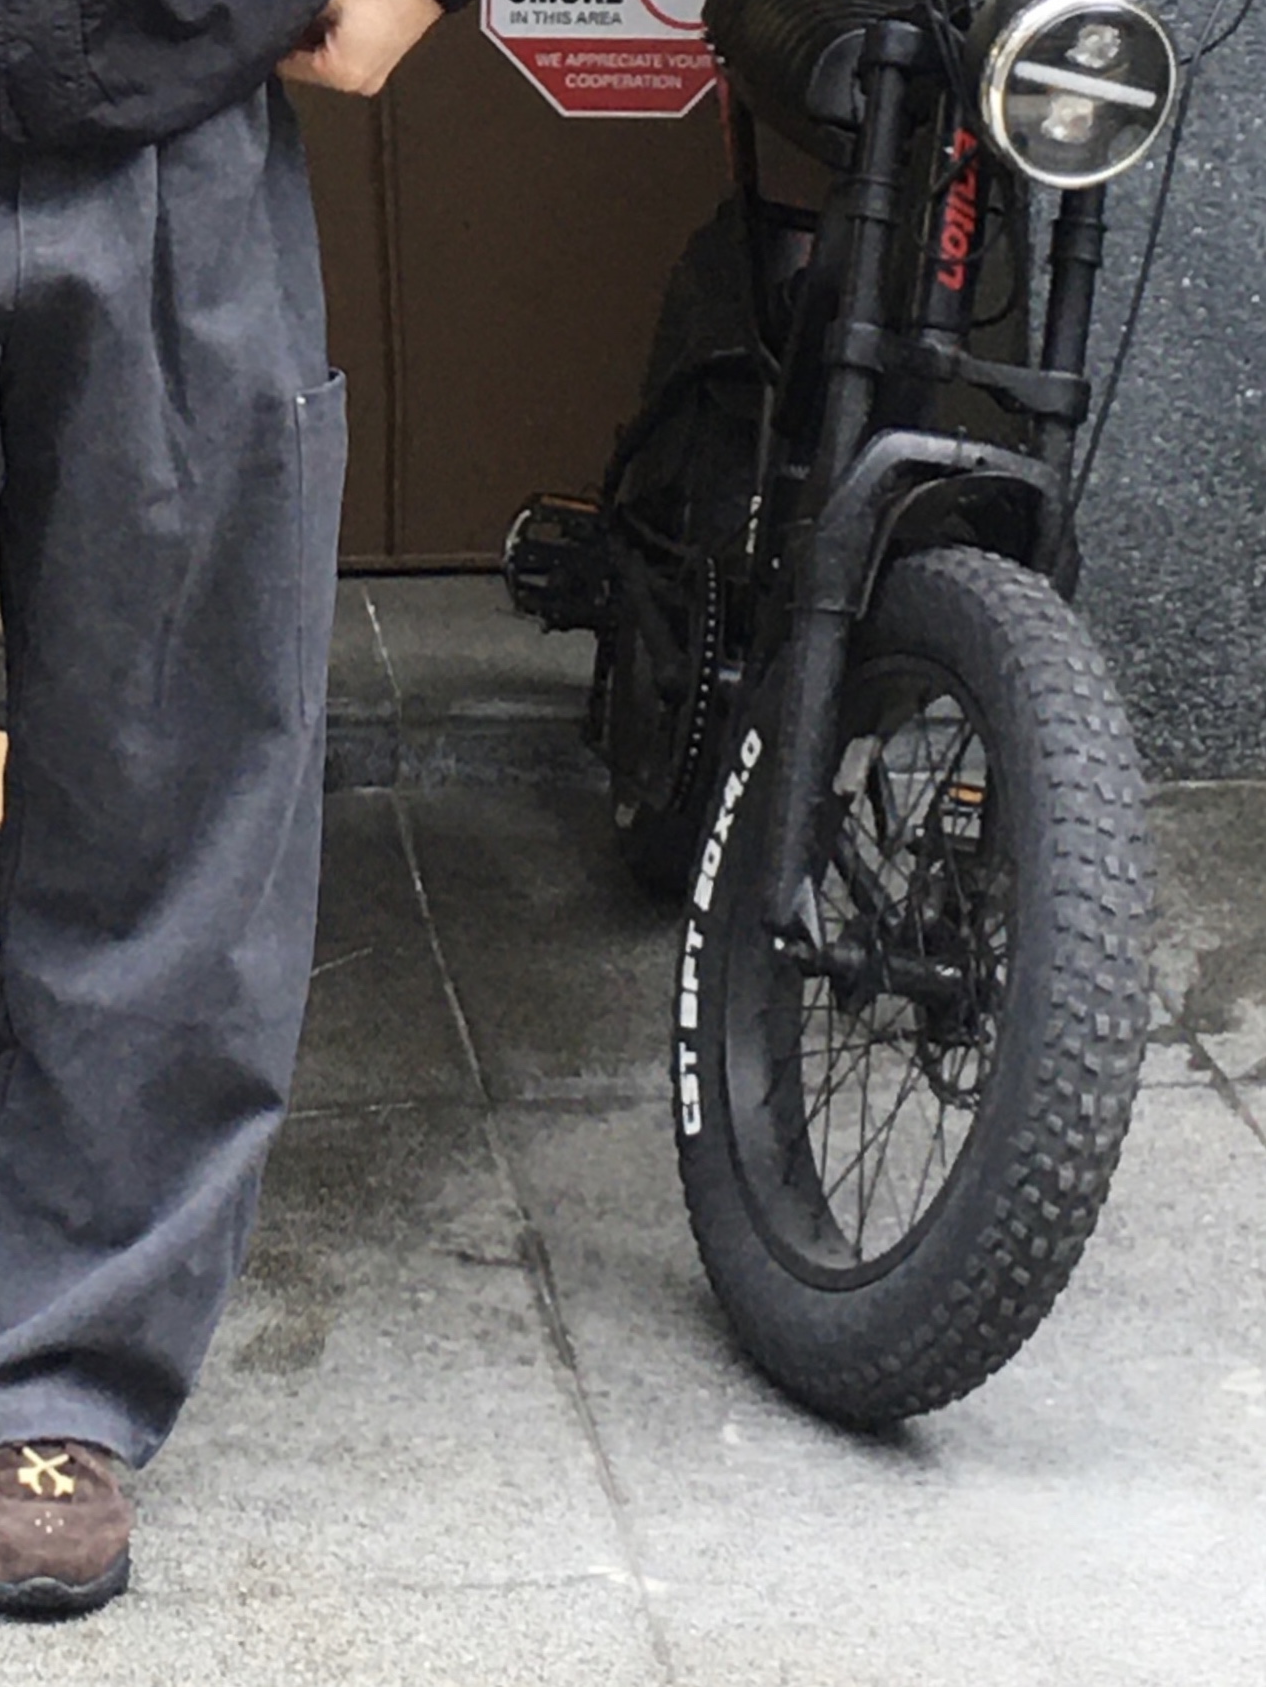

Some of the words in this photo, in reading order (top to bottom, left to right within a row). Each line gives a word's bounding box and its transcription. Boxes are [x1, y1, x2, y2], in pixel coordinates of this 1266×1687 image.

[510, 11, 529, 25] IN
[533, 11, 572, 25] THIS
[575, 11, 623, 25] AREA
[535, 52, 563, 67] WE
[565, 53, 663, 68] APPRECIATE
[565, 73, 683, 89] COOPERATION
[679, 1042, 702, 1136] CST
